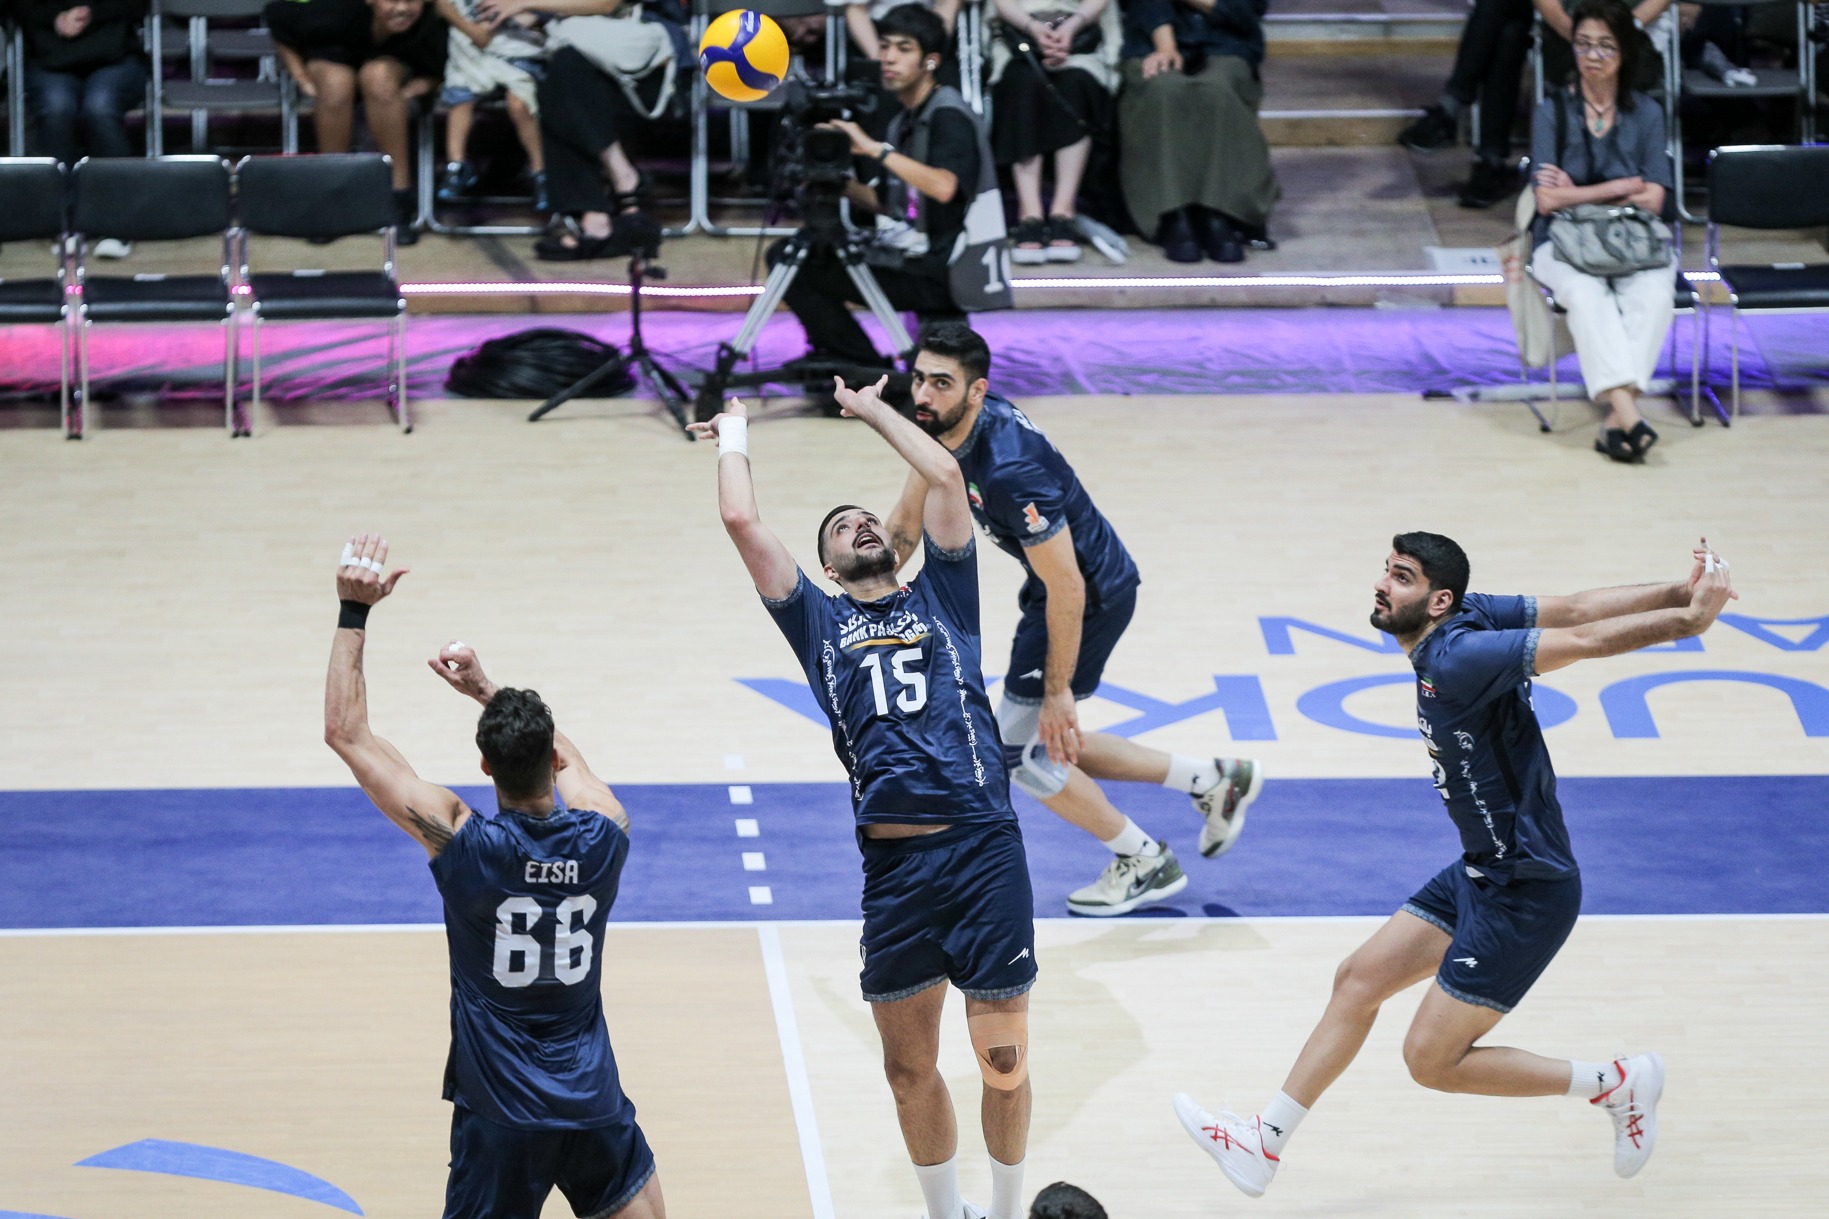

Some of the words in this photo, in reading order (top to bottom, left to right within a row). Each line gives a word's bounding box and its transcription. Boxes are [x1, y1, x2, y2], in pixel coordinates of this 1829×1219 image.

[839, 626, 869, 649] BANK
[859, 647, 927, 717] 15
[524, 859, 579, 884] EISA
[492, 893, 597, 988] 66
